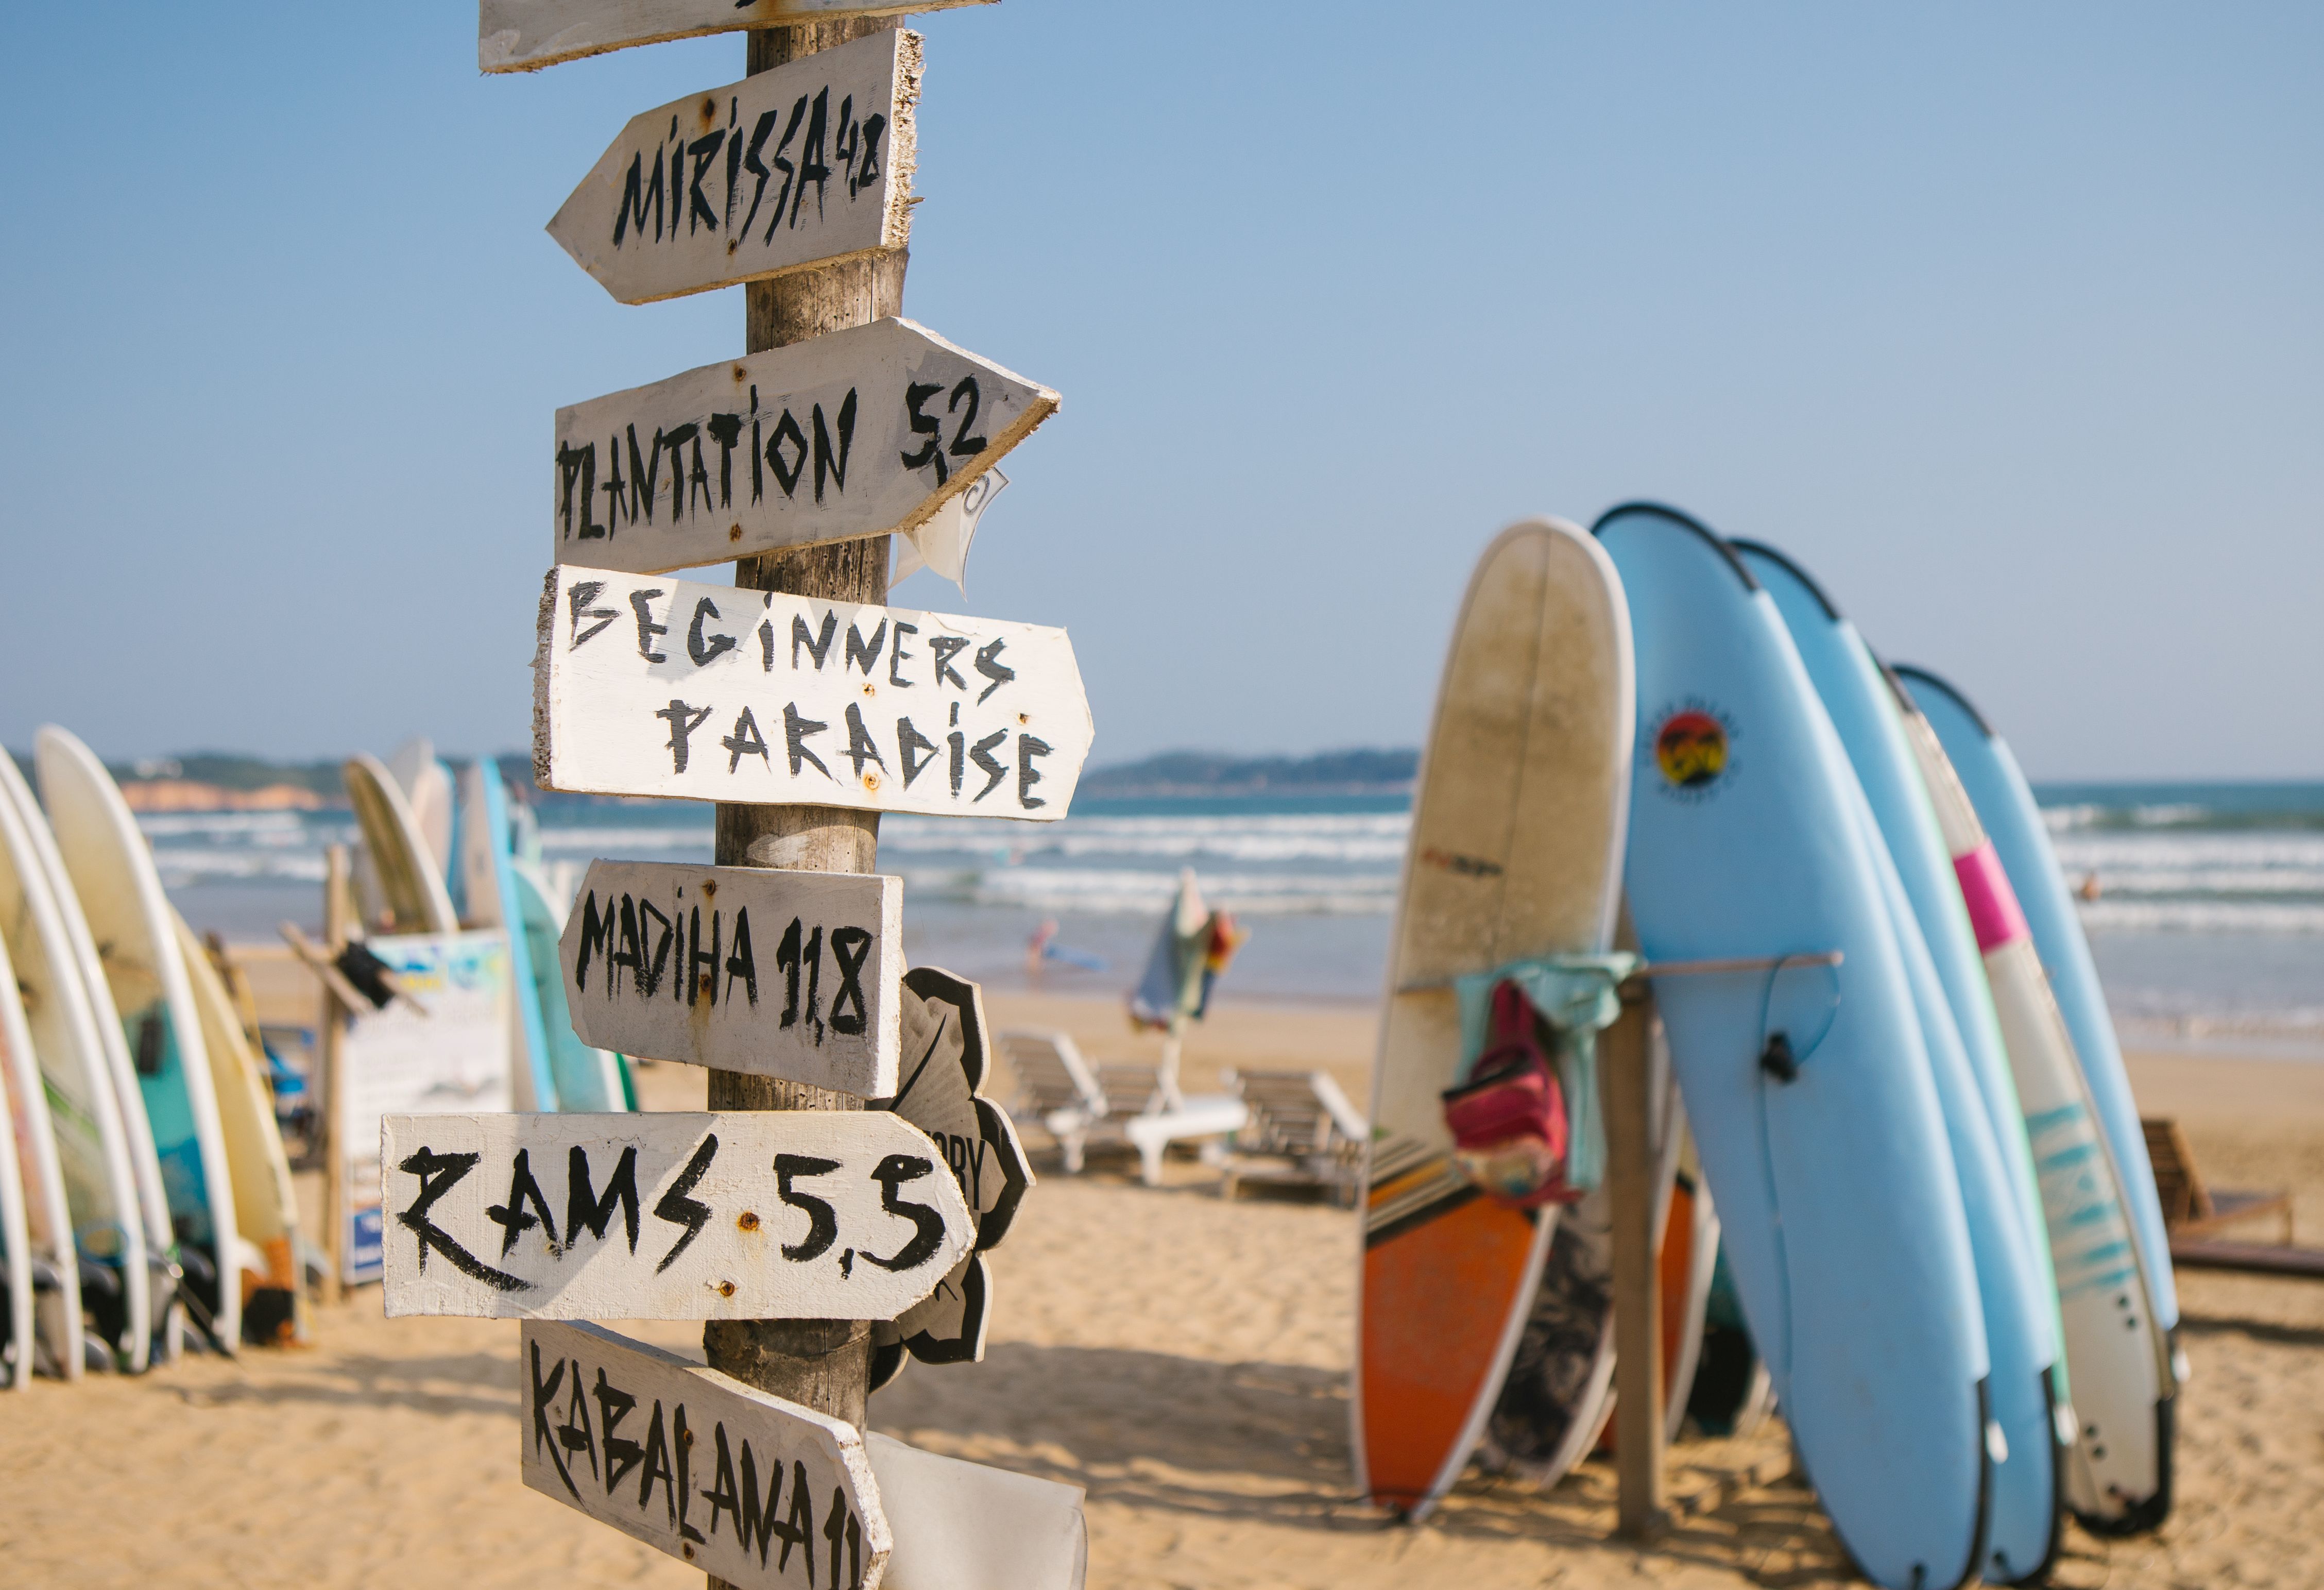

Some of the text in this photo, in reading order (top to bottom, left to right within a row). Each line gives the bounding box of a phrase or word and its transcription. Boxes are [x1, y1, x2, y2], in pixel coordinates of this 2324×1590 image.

[397, 1134, 719, 1292] RAMS
[773, 1153, 947, 1280] 5,5
[530, 1338, 815, 1589] KABALANA
